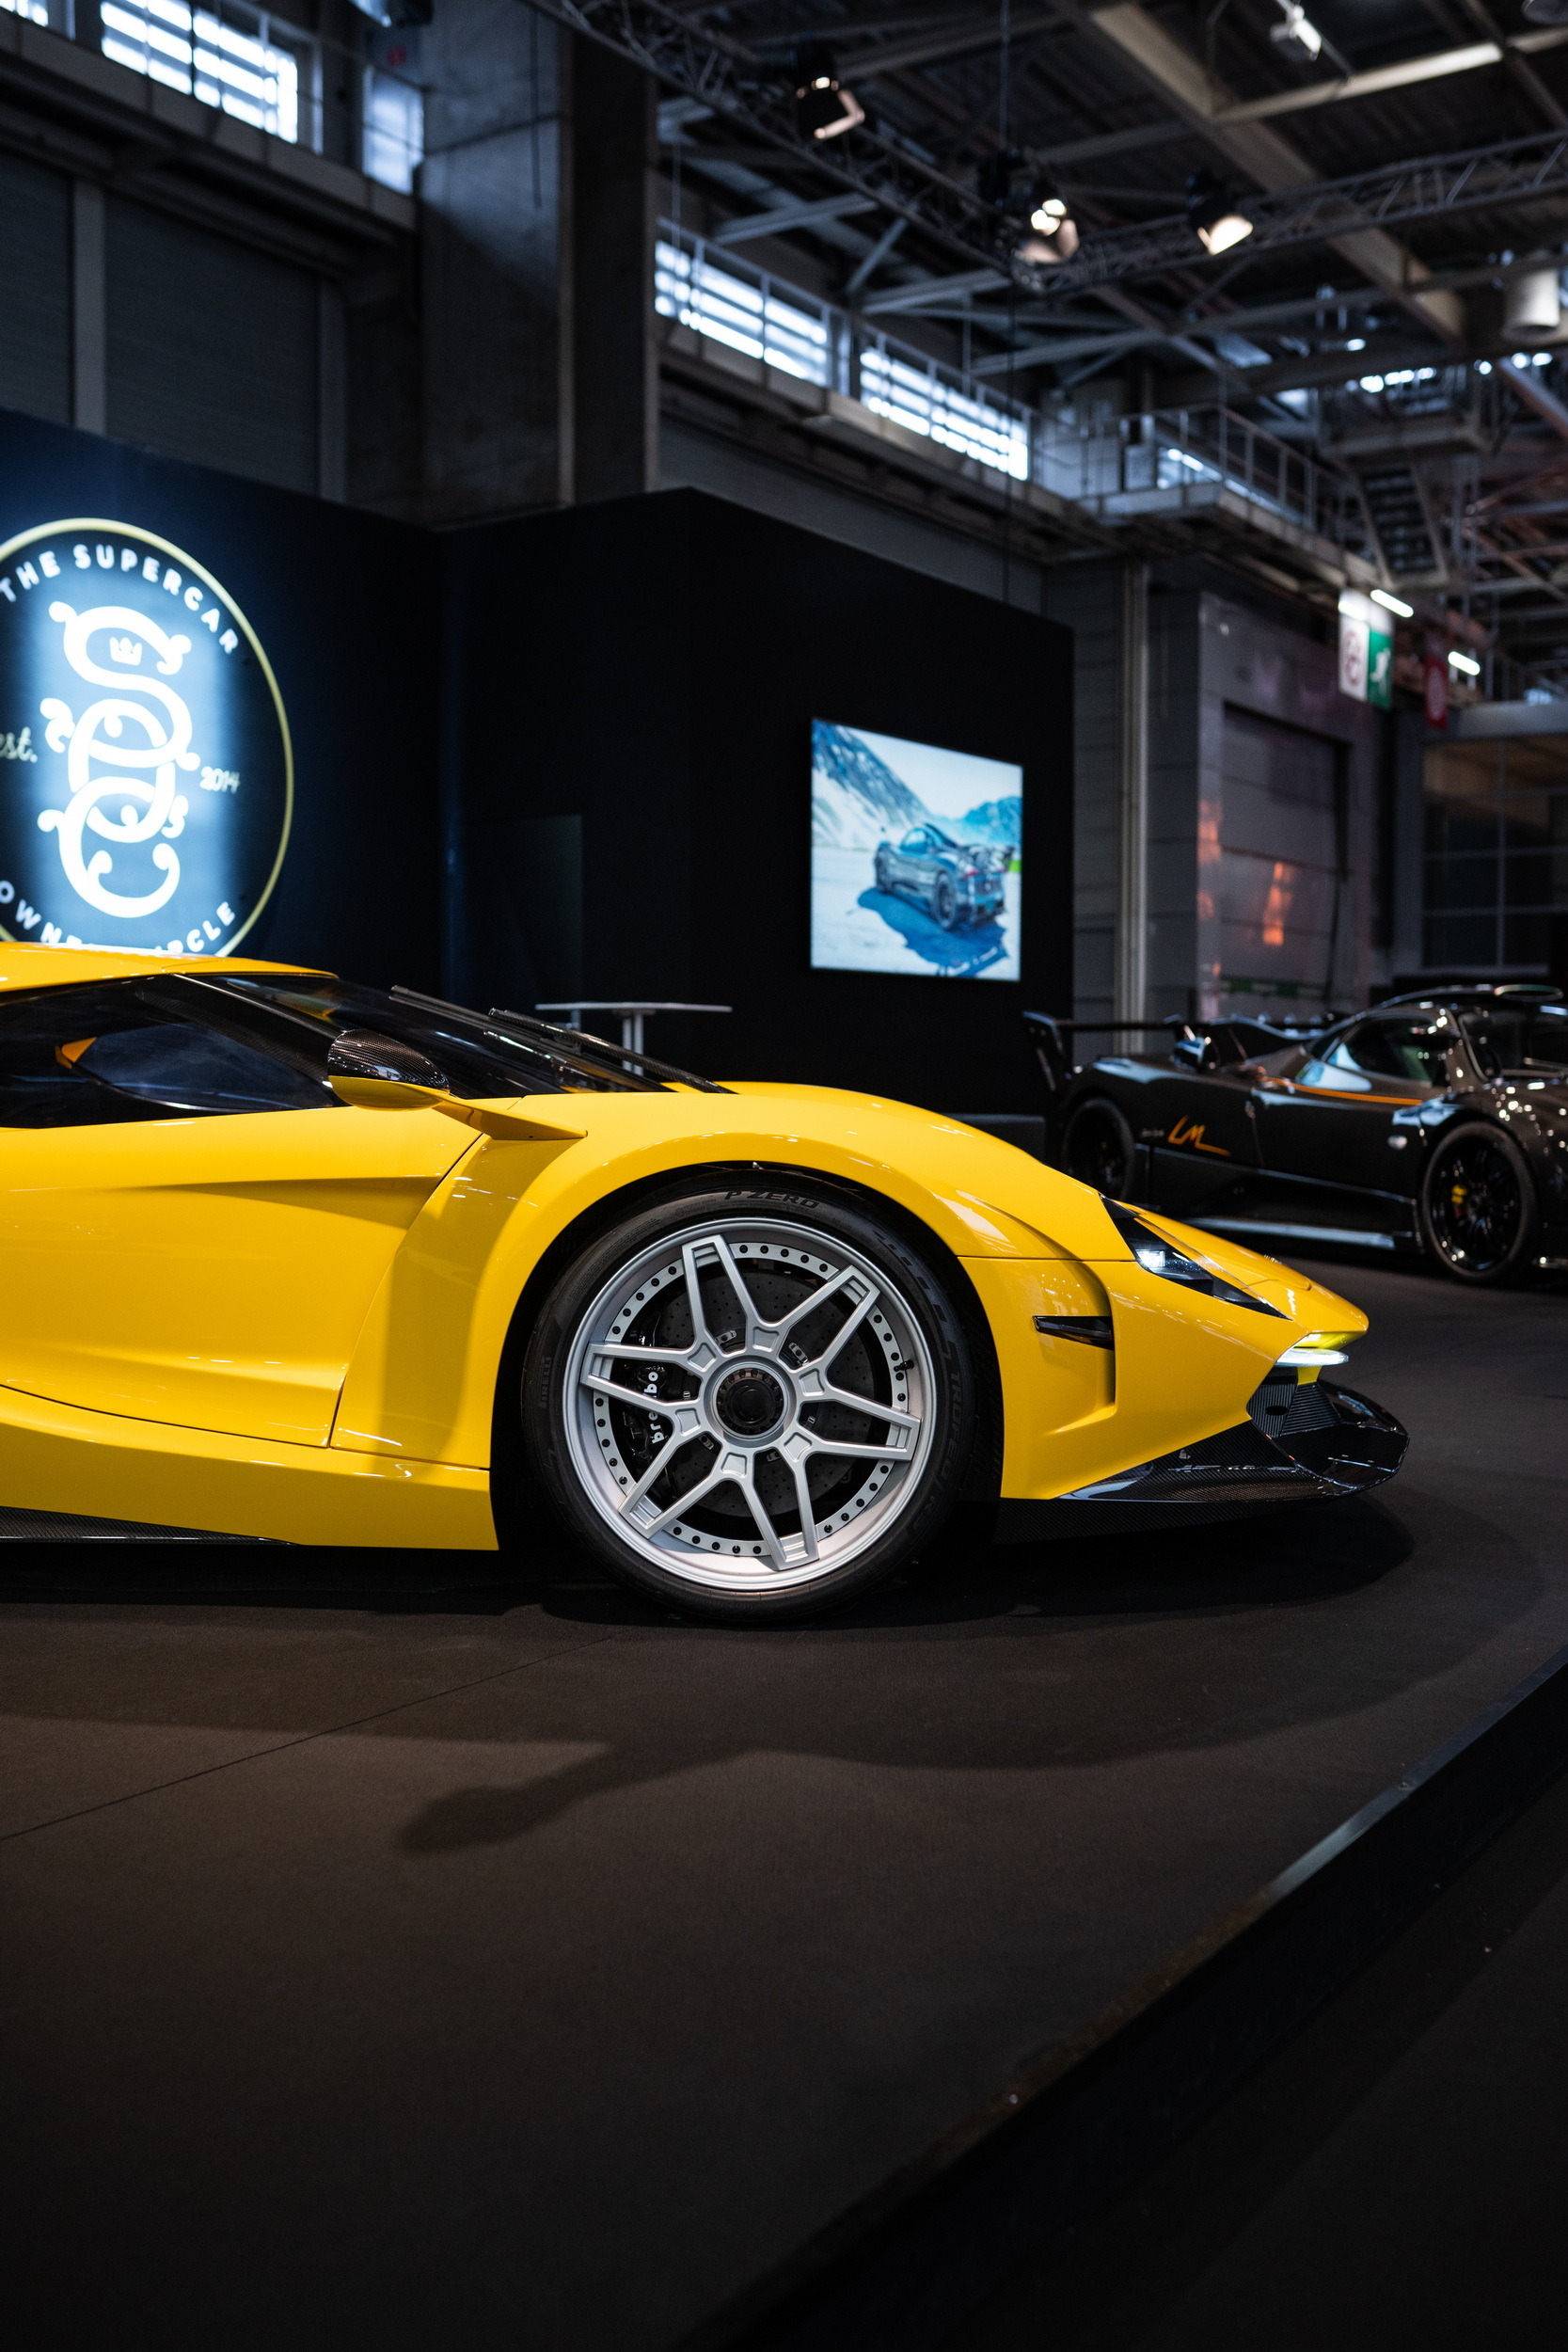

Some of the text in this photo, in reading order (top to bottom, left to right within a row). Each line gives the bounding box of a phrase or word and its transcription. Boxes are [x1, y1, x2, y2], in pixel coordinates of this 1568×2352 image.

[0, 544, 239, 654] THE SUPERCAR
[199, 766, 241, 793] 2014
[724, 1190, 821, 1209] P ZERO
[539, 1355, 552, 1408] PIRELLI
[643, 1371, 665, 1444] brebo
[940, 1371, 962, 1480] TROFEO
